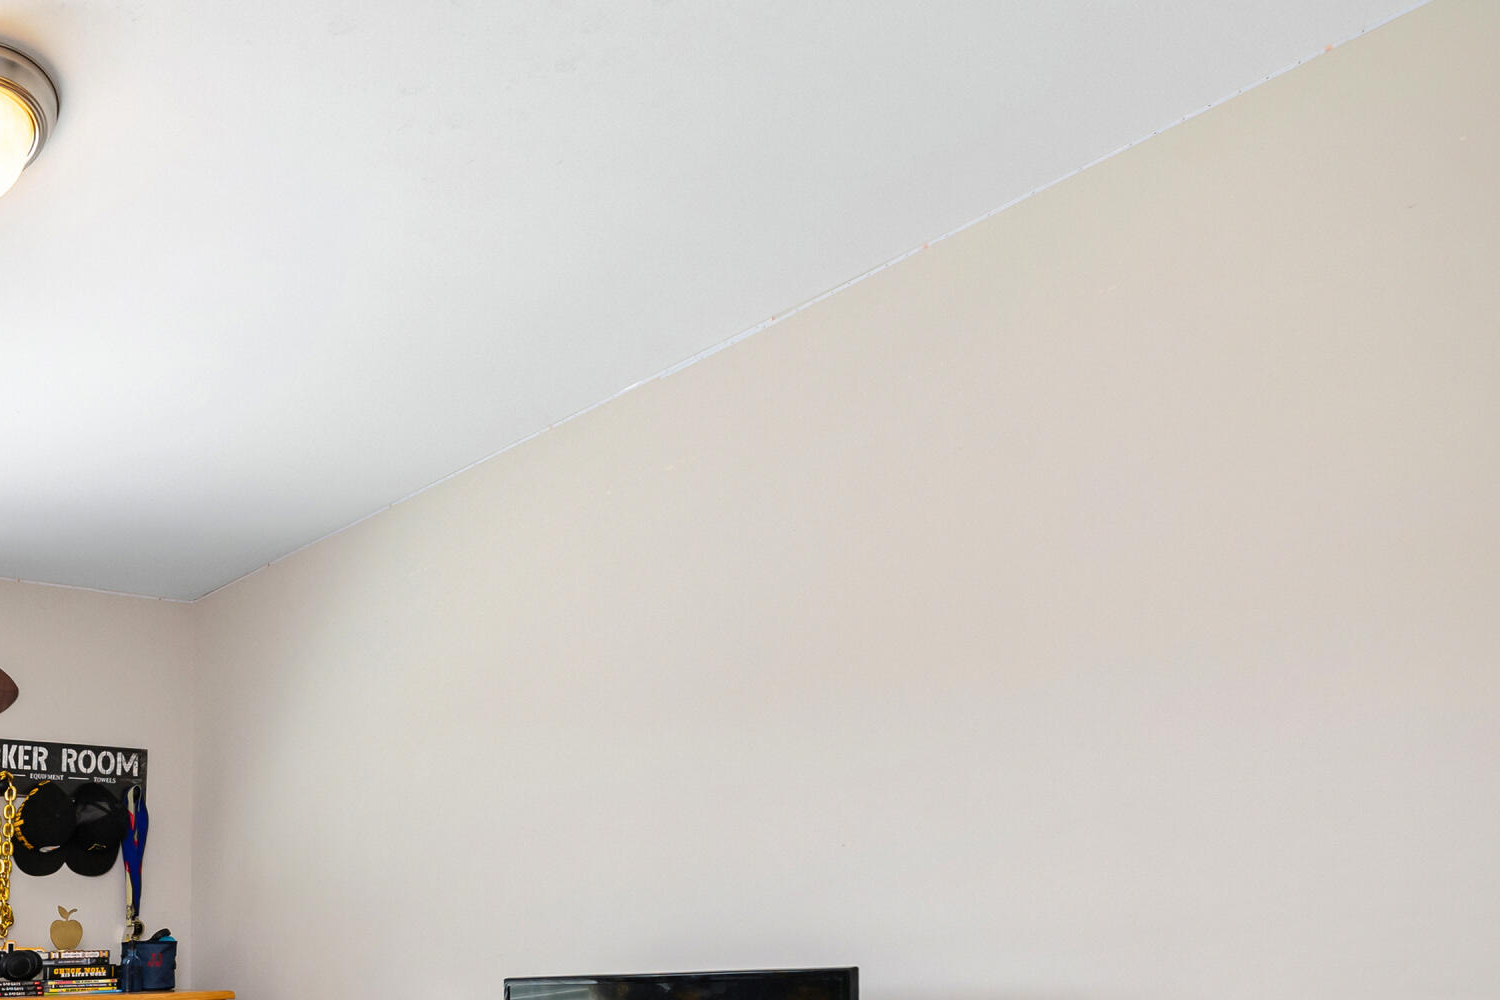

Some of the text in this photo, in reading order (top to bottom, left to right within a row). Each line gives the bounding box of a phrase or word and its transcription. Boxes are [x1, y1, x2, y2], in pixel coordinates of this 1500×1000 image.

[61, 748, 139, 777] ROOM
[30, 773, 65, 782] EQUIPMENT
[93, 776, 116, 784] TOWELS
[53, 967, 82, 975] CHUCK
